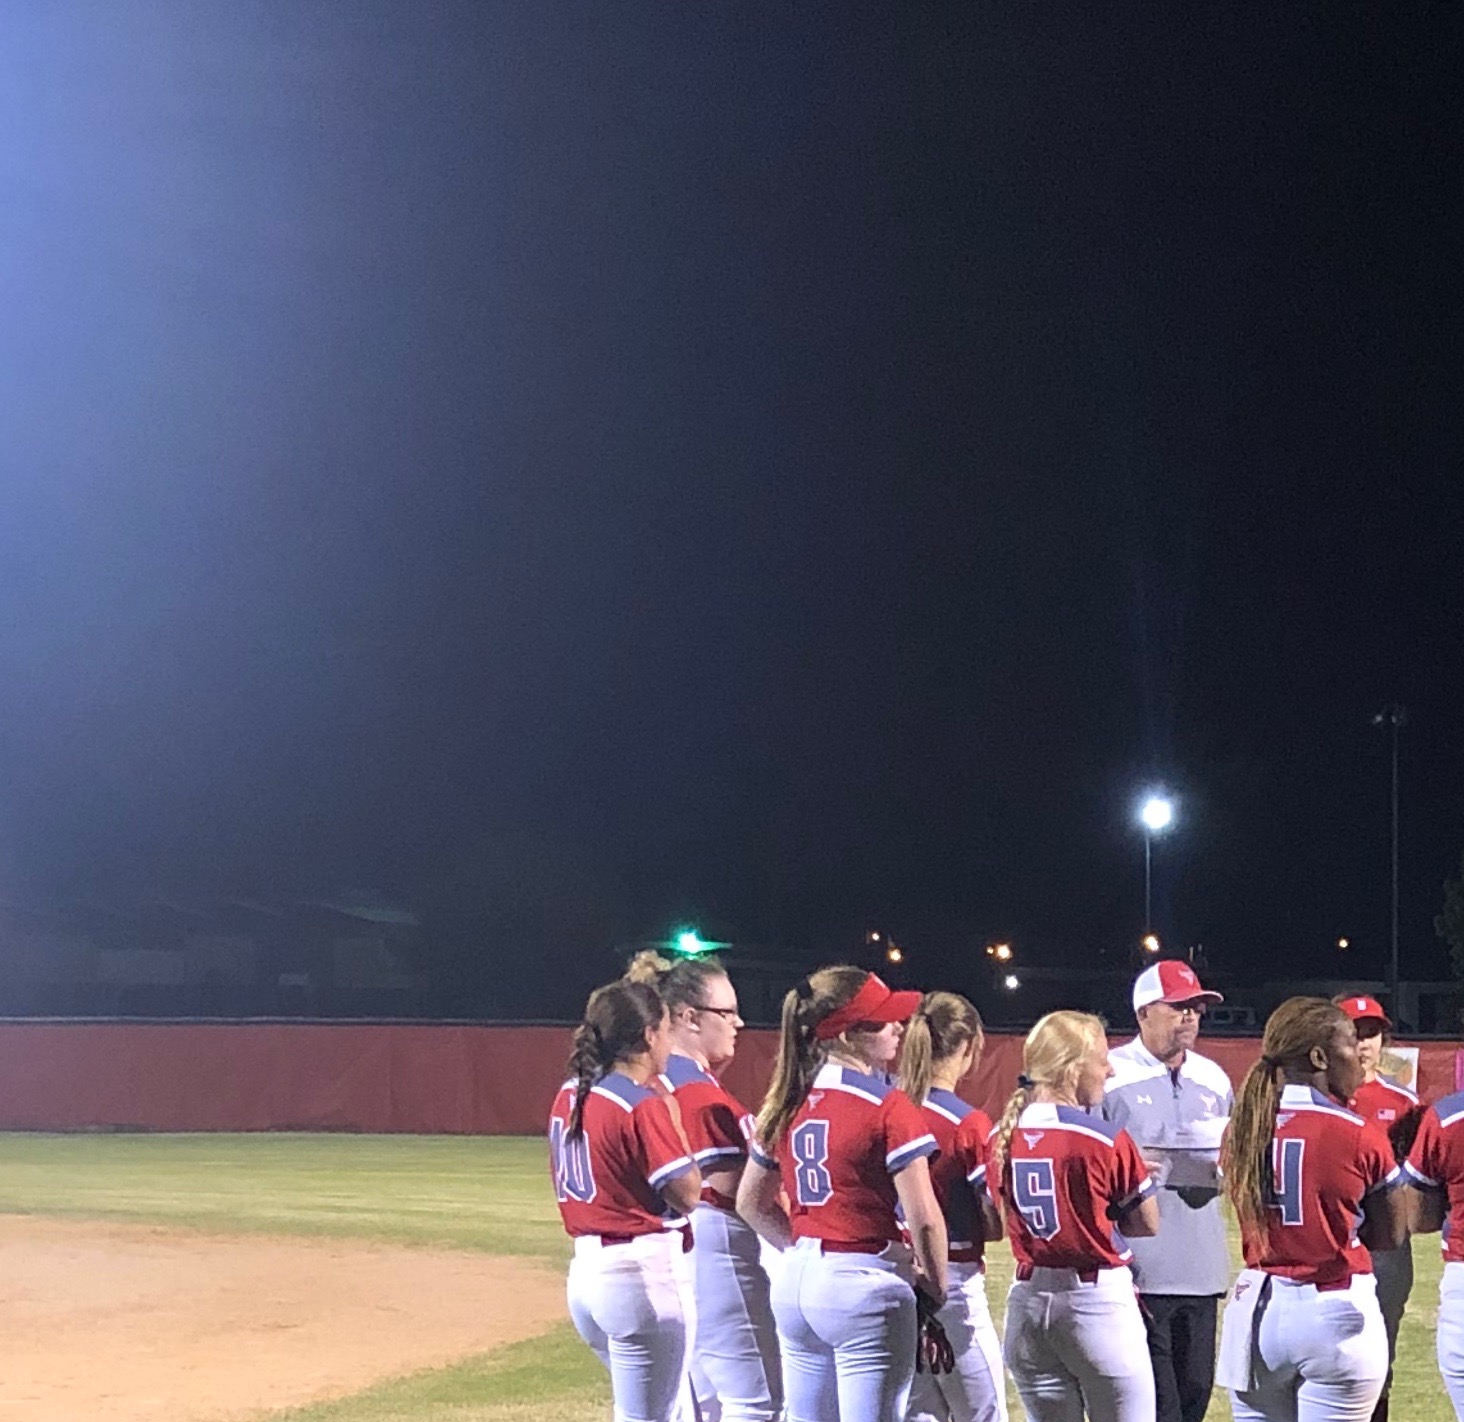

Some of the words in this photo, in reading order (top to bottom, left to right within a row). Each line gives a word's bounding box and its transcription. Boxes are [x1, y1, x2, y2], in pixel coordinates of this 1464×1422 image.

[551, 1117, 597, 1204] 10
[791, 1119, 834, 1206] 8
[1011, 1158, 1061, 1242] 5
[1268, 1138, 1305, 1226] 4
